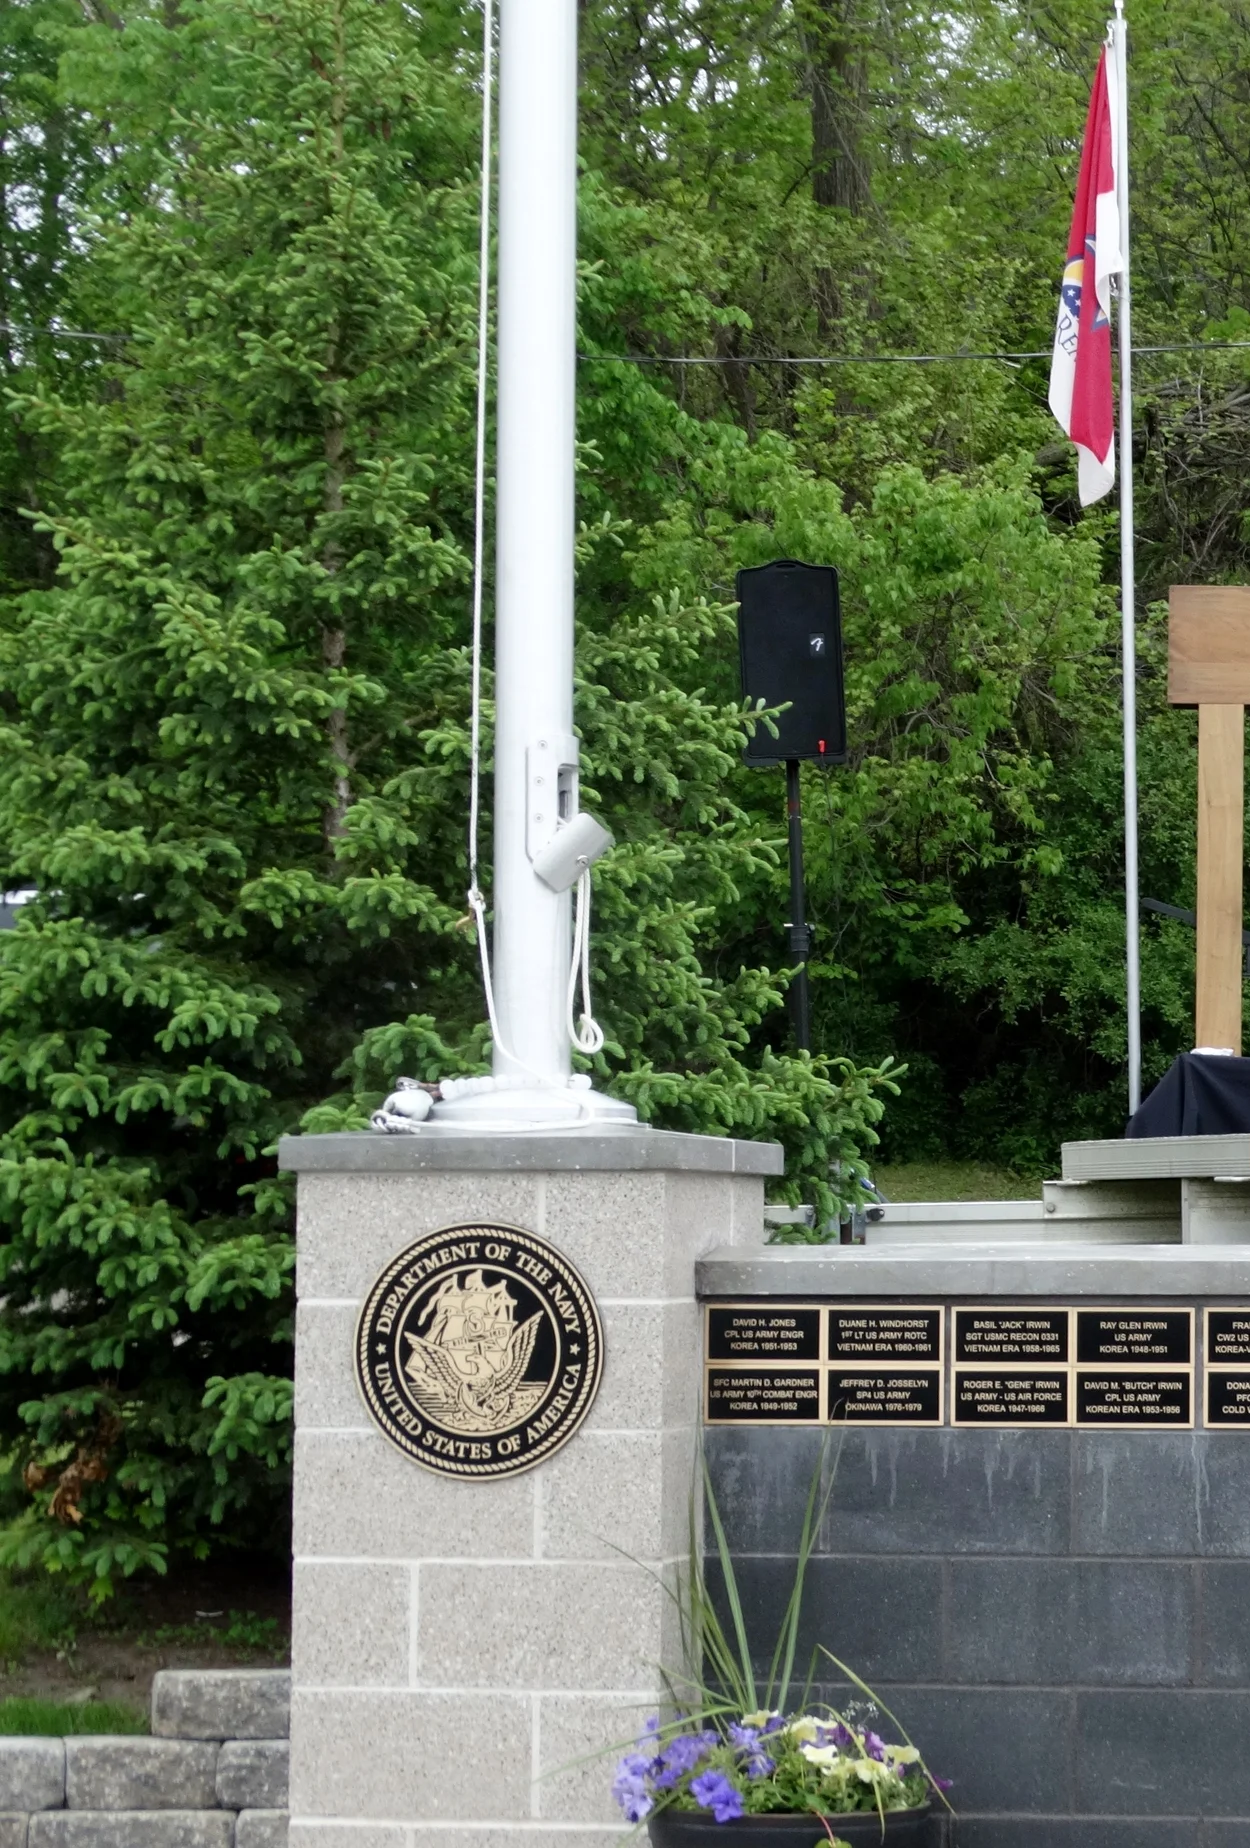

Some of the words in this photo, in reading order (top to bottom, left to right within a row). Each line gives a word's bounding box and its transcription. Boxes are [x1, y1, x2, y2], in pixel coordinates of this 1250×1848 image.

[376, 1242, 480, 1335] DEPARTMENT
[485, 1243, 511, 1259] OF
[517, 1251, 550, 1284] THE
[549, 1283, 581, 1334] NAVY
[769, 1319, 796, 1327] JONES
[839, 1319, 867, 1328] DUANE
[879, 1320, 929, 1328] WINDHORST
[1100, 1321, 1117, 1329] RAY
[1118, 1321, 1141, 1329] GLEN
[725, 1330, 740, 1338] CPL
[742, 1330, 753, 1338] US
[755, 1330, 779, 1338] ARMY
[780, 1330, 804, 1339] ENGR
[966, 1332, 983, 1341] SGT
[984, 1332, 1008, 1341] USMC
[1010, 1333, 1039, 1341] RECON
[1237, 1334, 1249, 1342] US
[731, 1342, 759, 1350] KOREA
[837, 1343, 873, 1351] VIETNAM
[875, 1343, 892, 1351] ERA
[964, 1344, 1001, 1352] VIETNAM
[1002, 1344, 1020, 1352] ERA
[1100, 1345, 1129, 1353] KOREA
[731, 1378, 762, 1386] MARTIN
[774, 1378, 814, 1387] GARDNER
[839, 1379, 875, 1387] JEFFREY
[887, 1379, 928, 1388] JOSSELYN
[873, 1391, 885, 1399] US
[886, 1391, 911, 1399] ARMY
[1105, 1393, 1122, 1402] CPL
[1123, 1393, 1135, 1402] US
[1136, 1393, 1161, 1401] ARMY
[730, 1402, 758, 1410] KOREA
[1086, 1405, 1120, 1413] KOREAN
[1122, 1405, 1140, 1413] ERA
[375, 1363, 422, 1437] UNITED
[422, 1430, 492, 1459] STATES
[497, 1435, 523, 1455] OF
[527, 1364, 581, 1443] AMERICA
